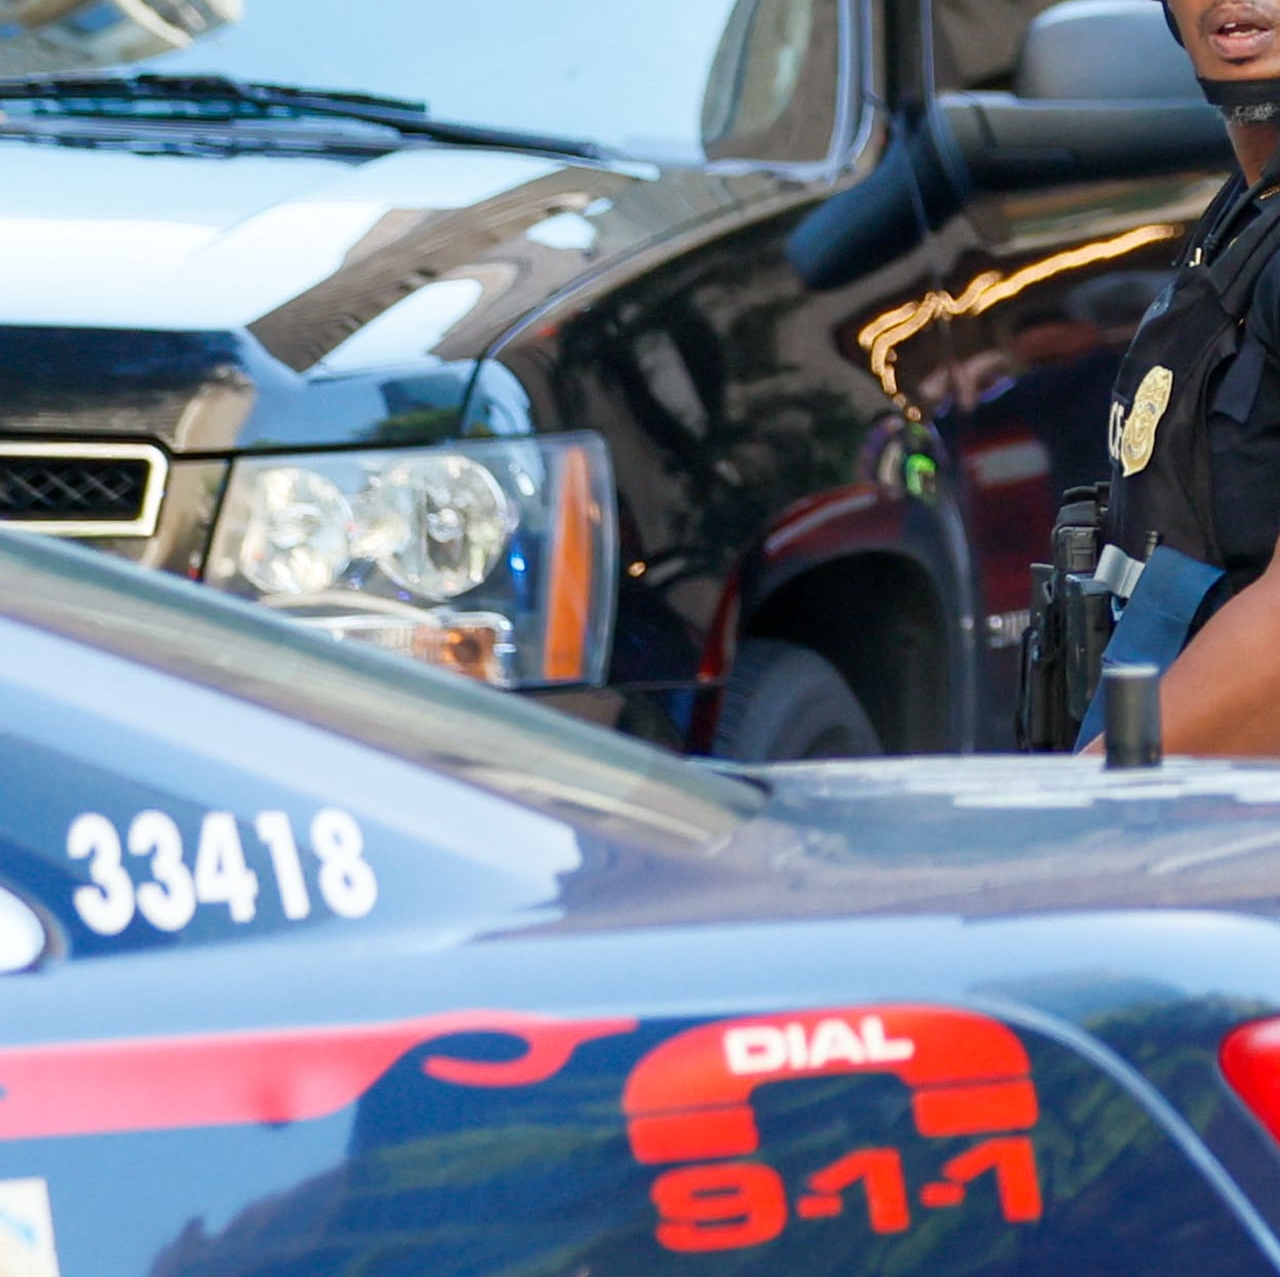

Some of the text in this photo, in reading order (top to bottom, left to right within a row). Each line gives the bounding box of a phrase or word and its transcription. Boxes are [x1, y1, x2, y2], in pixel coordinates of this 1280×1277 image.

[66, 806, 379, 937] 33418
[722, 1015, 916, 1076] DIAL
[650, 1135, 1044, 1254] 9-1-1
